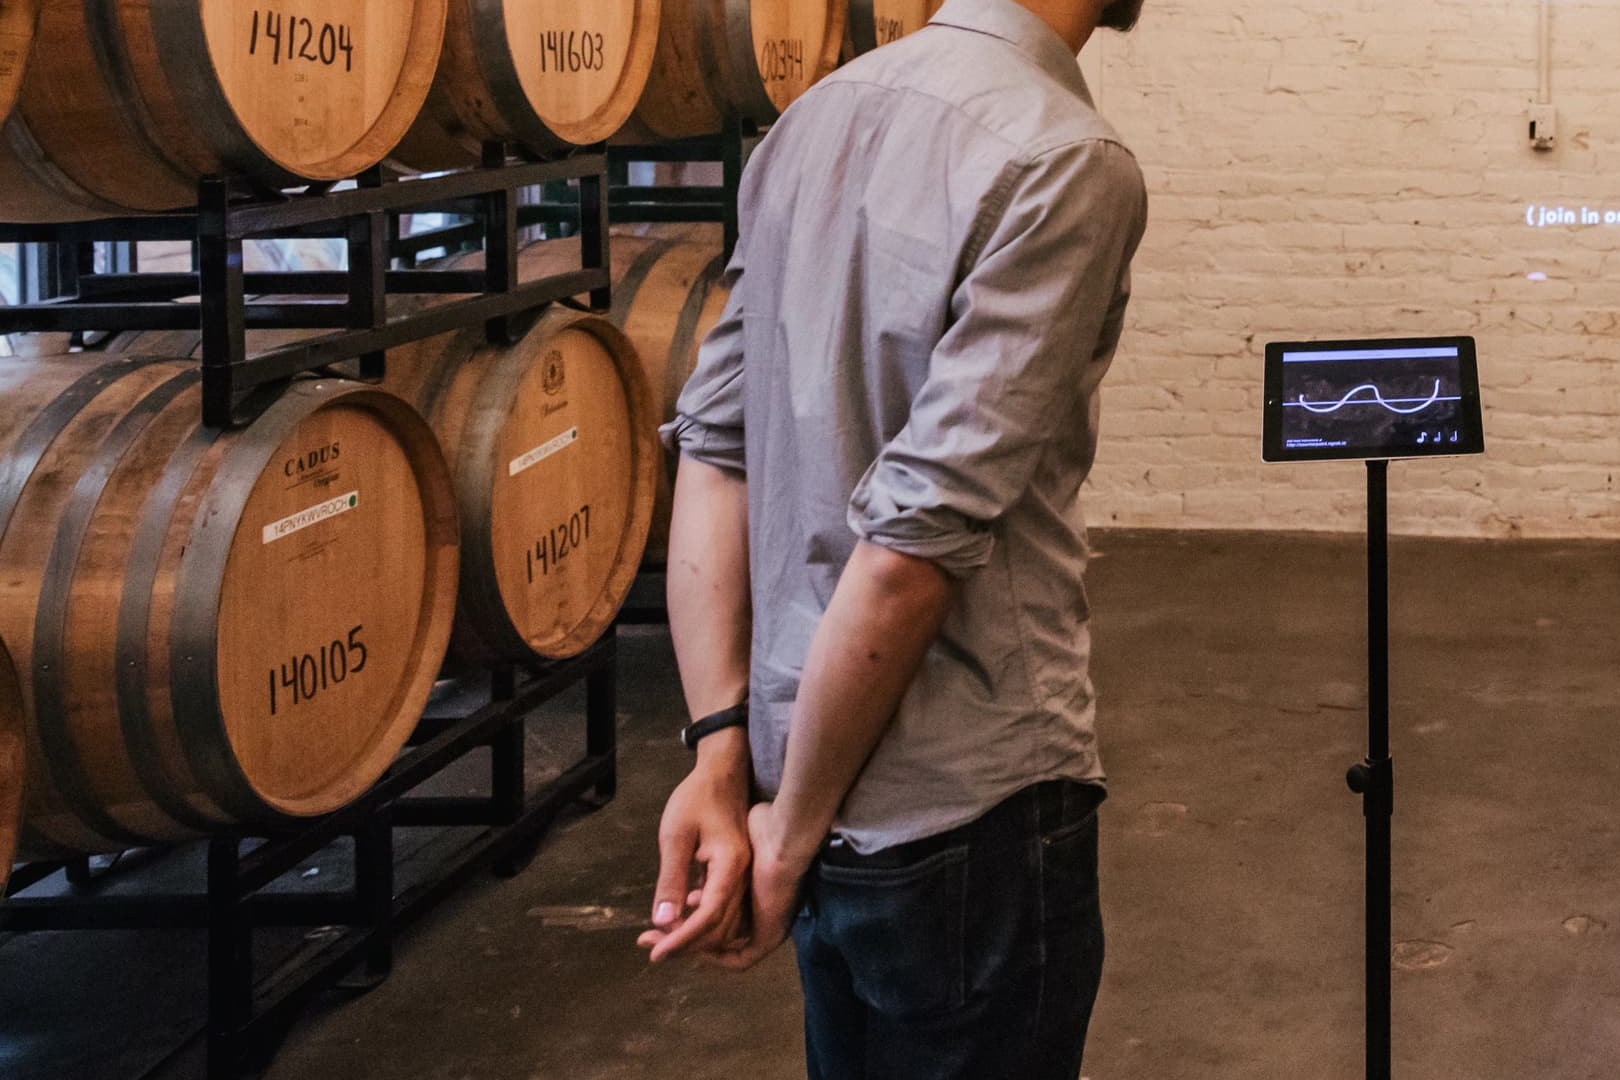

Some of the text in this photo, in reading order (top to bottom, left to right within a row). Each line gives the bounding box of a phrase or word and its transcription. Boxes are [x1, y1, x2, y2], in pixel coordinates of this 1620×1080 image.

[250, 10, 353, 72] 141204
[540, 30, 604, 73] 141603
[1538, 205, 1576, 228] join
[1581, 206, 1600, 224] in
[284, 441, 340, 477] CADUS
[527, 504, 589, 584] 141207
[269, 624, 367, 716] 140105
